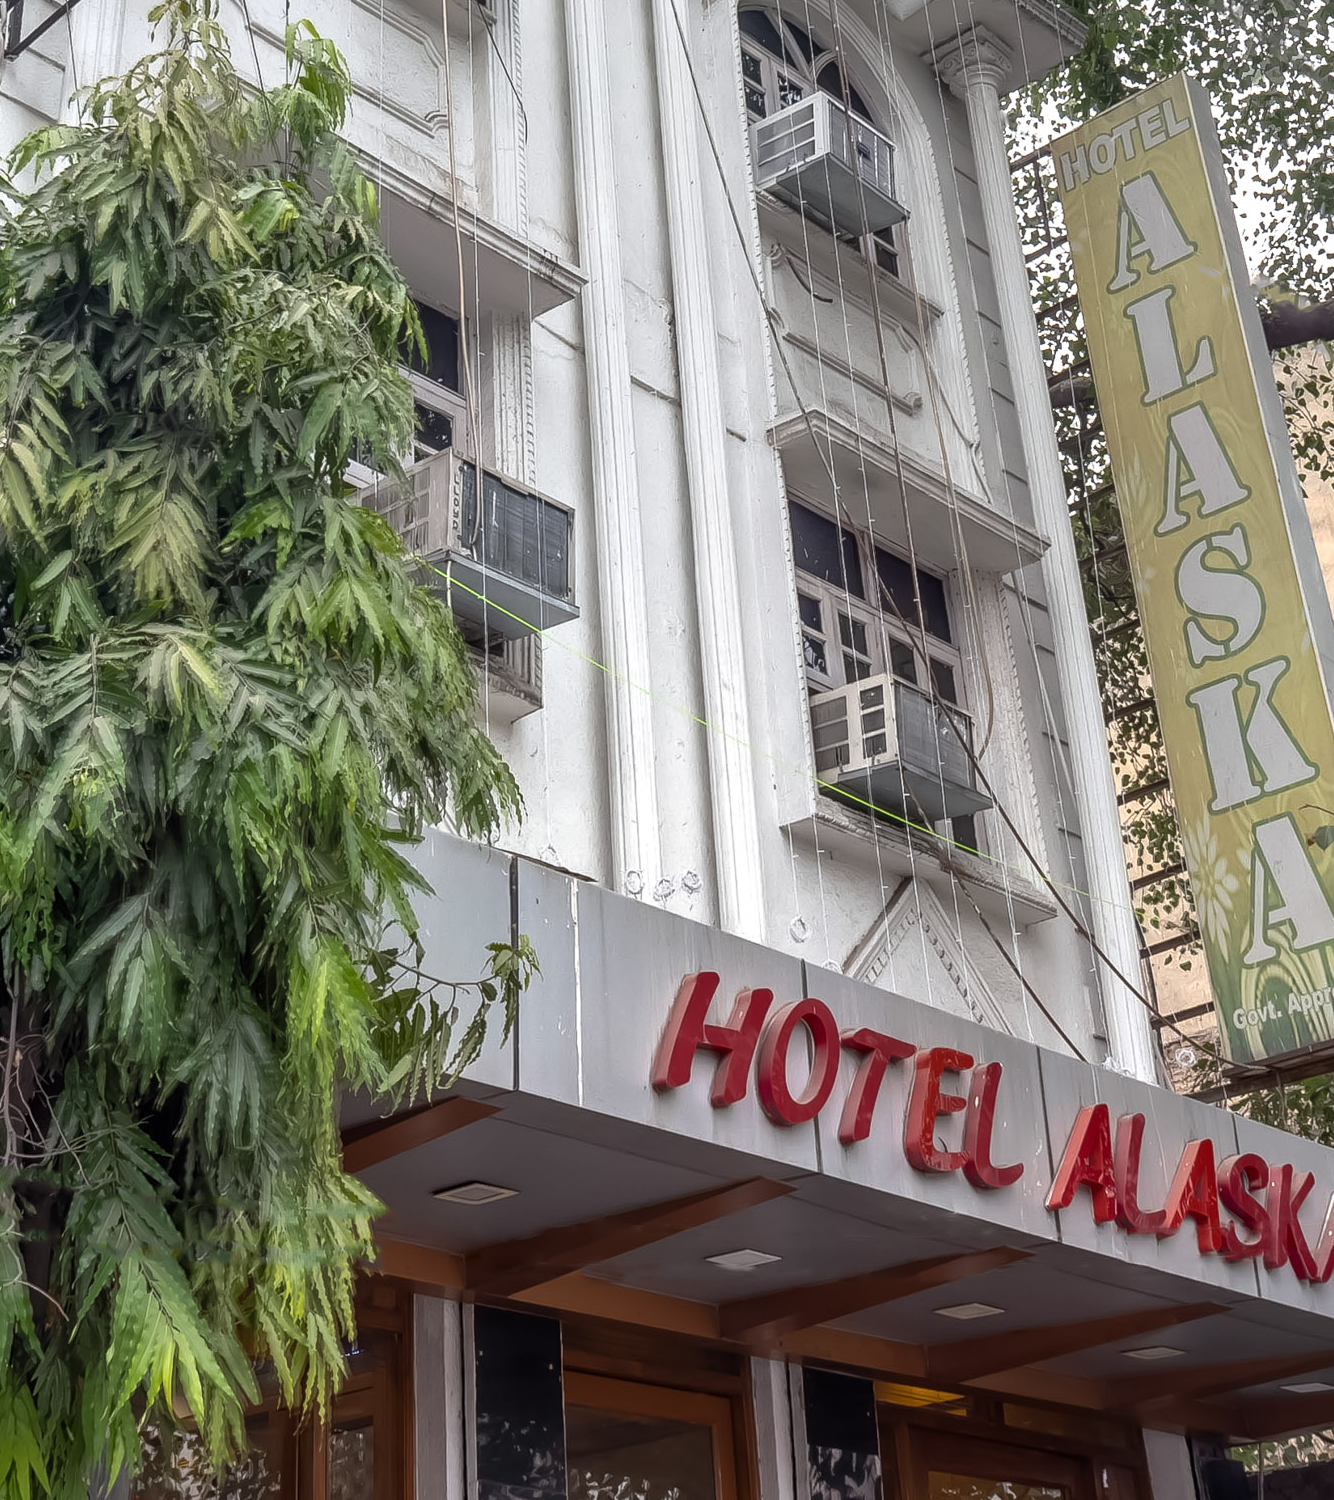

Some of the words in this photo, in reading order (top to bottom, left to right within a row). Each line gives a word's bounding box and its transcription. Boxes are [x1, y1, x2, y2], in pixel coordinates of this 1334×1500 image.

[1059, 98, 1192, 192] HOTEL
[1232, 999, 1283, 1030] Govt.
[650, 970, 1025, 1190] HOTEL
